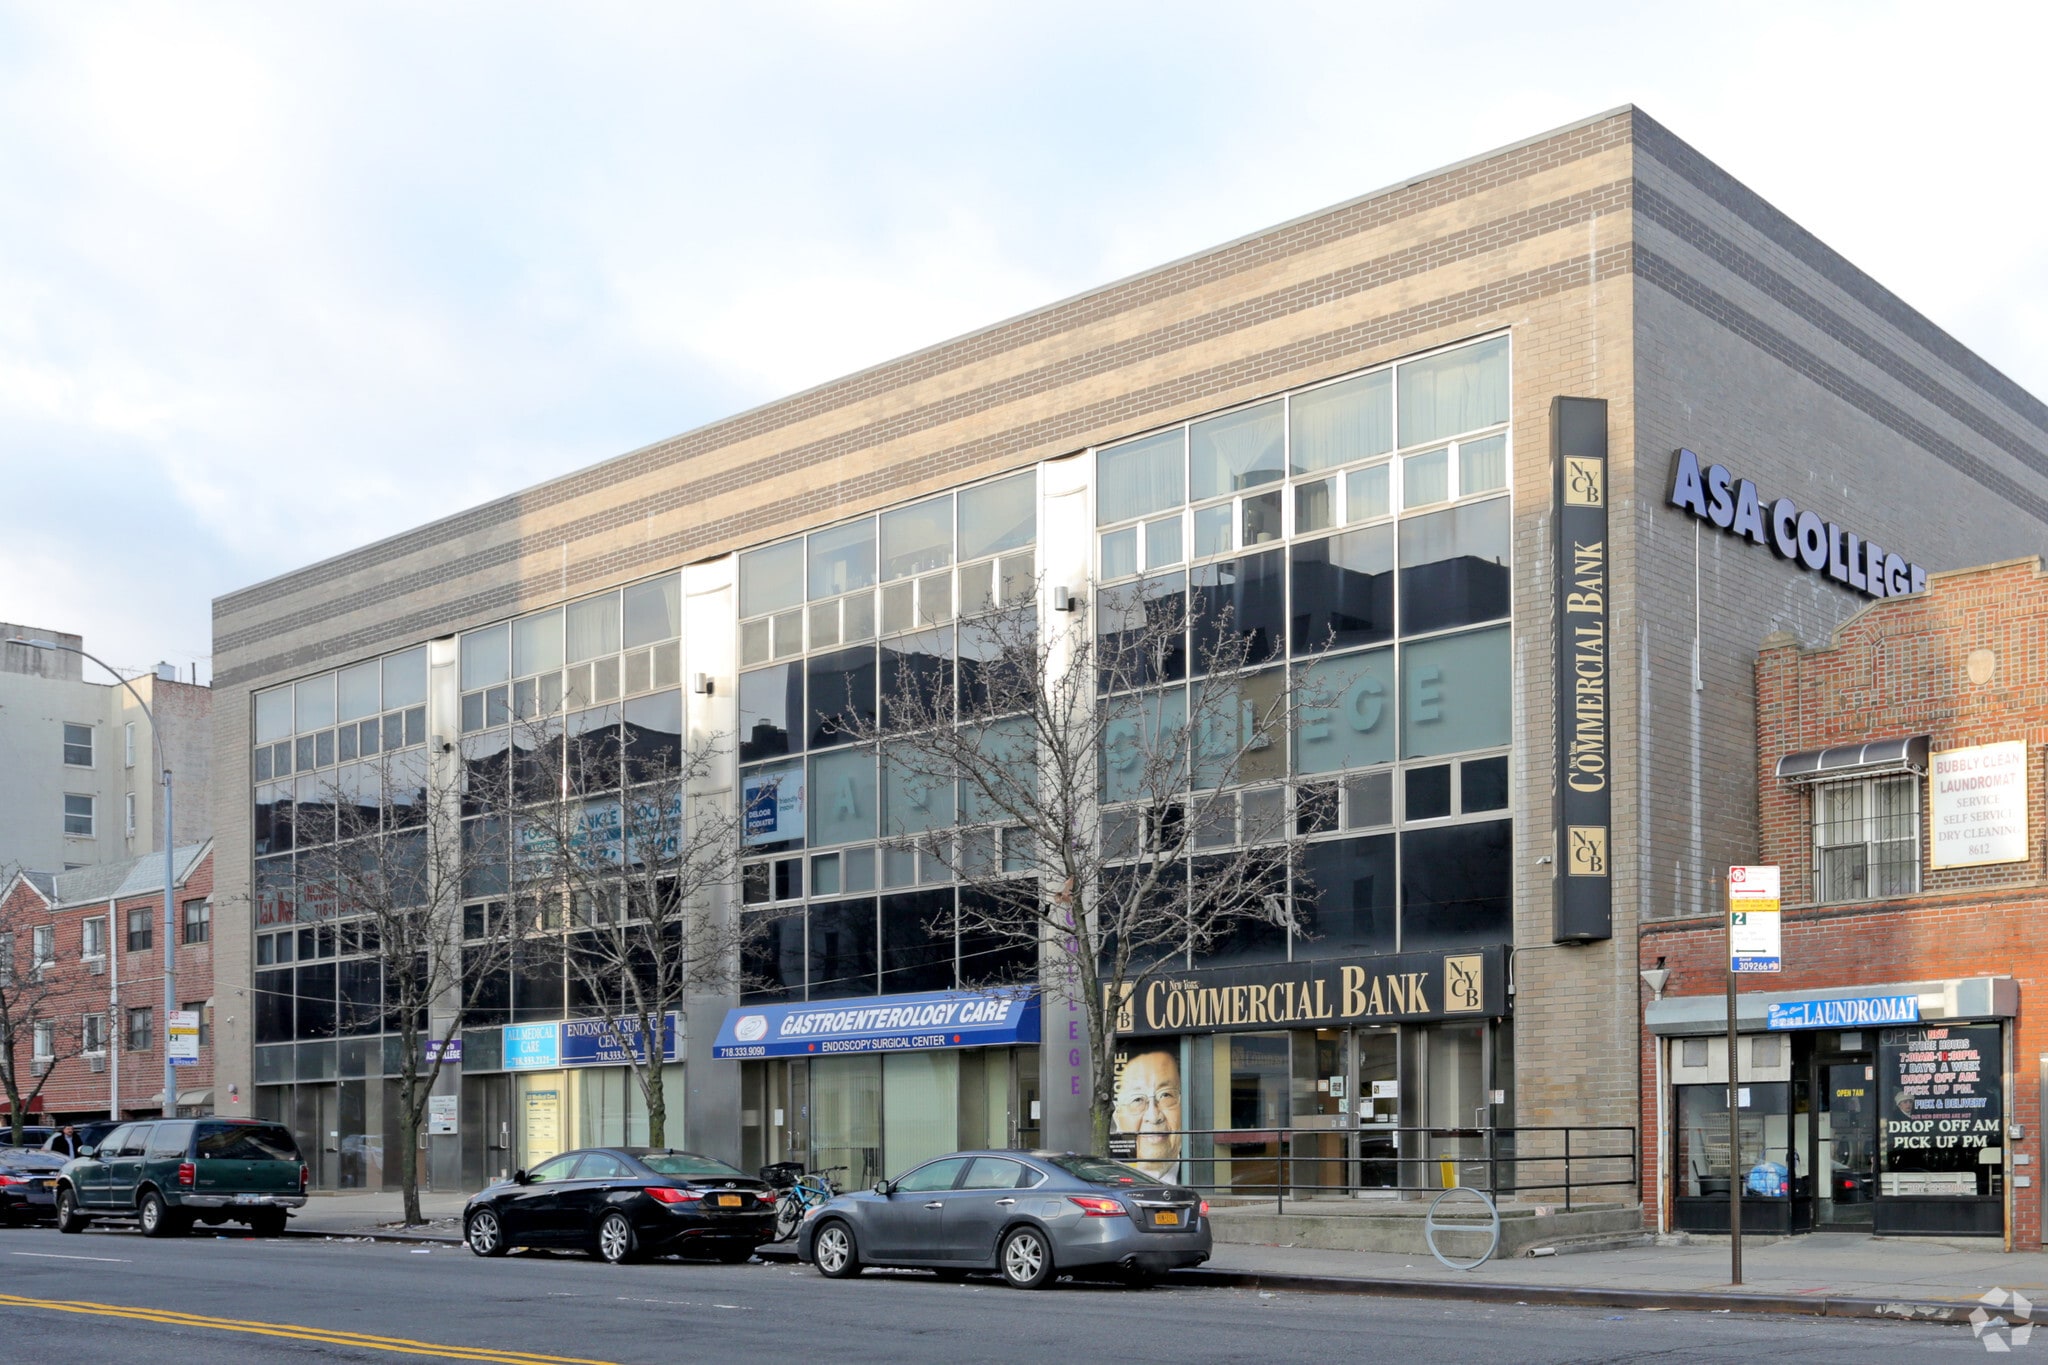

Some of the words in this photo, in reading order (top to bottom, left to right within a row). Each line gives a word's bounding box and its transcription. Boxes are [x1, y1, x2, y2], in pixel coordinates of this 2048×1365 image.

[1668, 448, 1765, 545] ASA
[1567, 541, 1603, 615] BANK
[1568, 621, 1605, 792] COMMERCIAL
[1937, 757, 1979, 774] BUBBLY
[1983, 752, 2020, 768] CLEAN
[1940, 773, 2016, 794] LAUNDROMAT
[1957, 795, 1999, 808] SERVICE
[748, 818, 775, 828] PODIATRY
[1943, 813, 1969, 825] SELF
[1938, 830, 1961, 841] DRY
[1968, 844, 1990, 855] 8612
[1735, 913, 1743, 924] 2
[1739, 962, 1768, 970] 309266
[1146, 979, 1333, 1030] COMMERCIAL
[1341, 966, 1430, 1017] BANK
[1803, 996, 1918, 1026] LAUNDROMAT
[780, 1004, 955, 1036] GASTROENTEROLOGY
[959, 1000, 1011, 1024] CARE
[507, 1029, 520, 1040] ALL
[521, 1026, 554, 1040] MEDICAL
[567, 1020, 622, 1037] ENDOSCY
[1927, 1029, 1949, 1039] NEW
[520, 1040, 540, 1053] CARE
[822, 1039, 871, 1052] ENDOSCOPY
[872, 1037, 910, 1050] SURGICAL
[911, 1035, 945, 1047] CENTER
[1909, 1040, 1937, 1051] STORE
[1938, 1039, 1970, 1050] HOURS
[426, 1051, 437, 1060] ASA
[440, 1050, 461, 1060] LLEGE
[596, 1050, 638, 1061] 718.333.90
[721, 1046, 765, 1058] 718.333.9090
[1899, 1063, 1906, 1073] 7
[1909, 1062, 1936, 1073] DAYS
[1940, 1062, 1949, 1072] A
[1951, 1061, 1981, 1071] WEEK
[1114, 1052, 1128, 1101] OICE
[1901, 1073, 1932, 1084] DROP
[1934, 1073, 1956, 1083] OFF
[1958, 1072, 1980, 1082] AM.
[1836, 1089, 1851, 1097] OPEN
[1852, 1088, 1864, 1096] 7AM
[1903, 1085, 1930, 1095] PICK
[1933, 1084, 1949, 1094] UP
[1953, 1084, 1975, 1094] PM.
[1914, 1099, 1935, 1109] PICK
[1935, 1099, 1943, 1109] &
[1944, 1098, 1987, 1108] DELIVERY
[1889, 1120, 1934, 1133] DROP
[1938, 1119, 1971, 1132] OFF
[1972, 1118, 1999, 1132] AM
[1894, 1136, 1931, 1149] PICK
[1936, 1135, 1958, 1148] UP
[1962, 1135, 1988, 1148] PM
